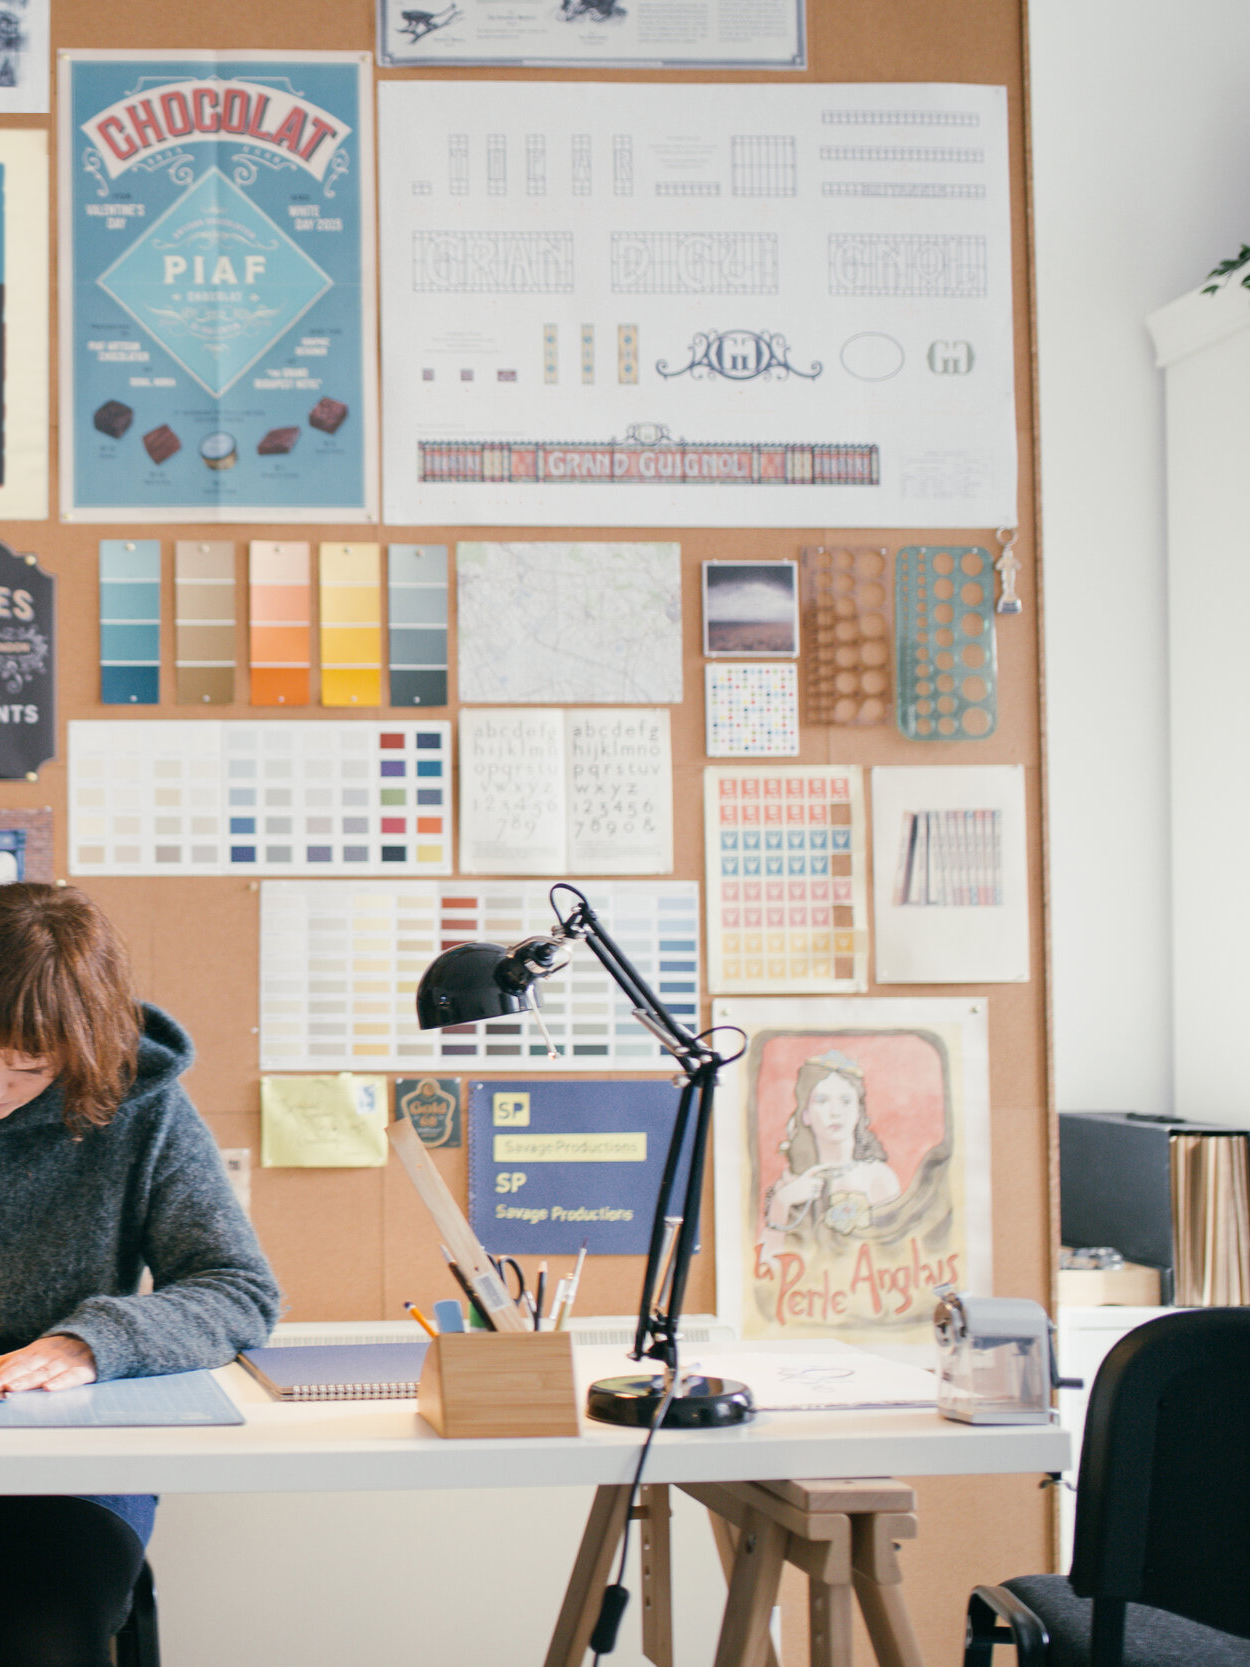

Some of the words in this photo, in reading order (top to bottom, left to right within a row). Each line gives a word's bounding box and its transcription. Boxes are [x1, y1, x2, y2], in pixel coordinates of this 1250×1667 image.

[97, 88, 337, 162] CHOCOLAT
[106, 217, 127, 229] DAY
[163, 255, 267, 285] PIAF
[548, 451, 629, 477] GRAND
[638, 452, 747, 478] GUIGNOL
[498, 1102, 524, 1119] SP
[504, 1140, 552, 1155] Savage
[556, 1139, 639, 1153] Productions
[495, 1172, 527, 1193] SP
[495, 1204, 548, 1224] Savage
[551, 1205, 634, 1222] Productions
[774, 1252, 848, 1325] Perle
